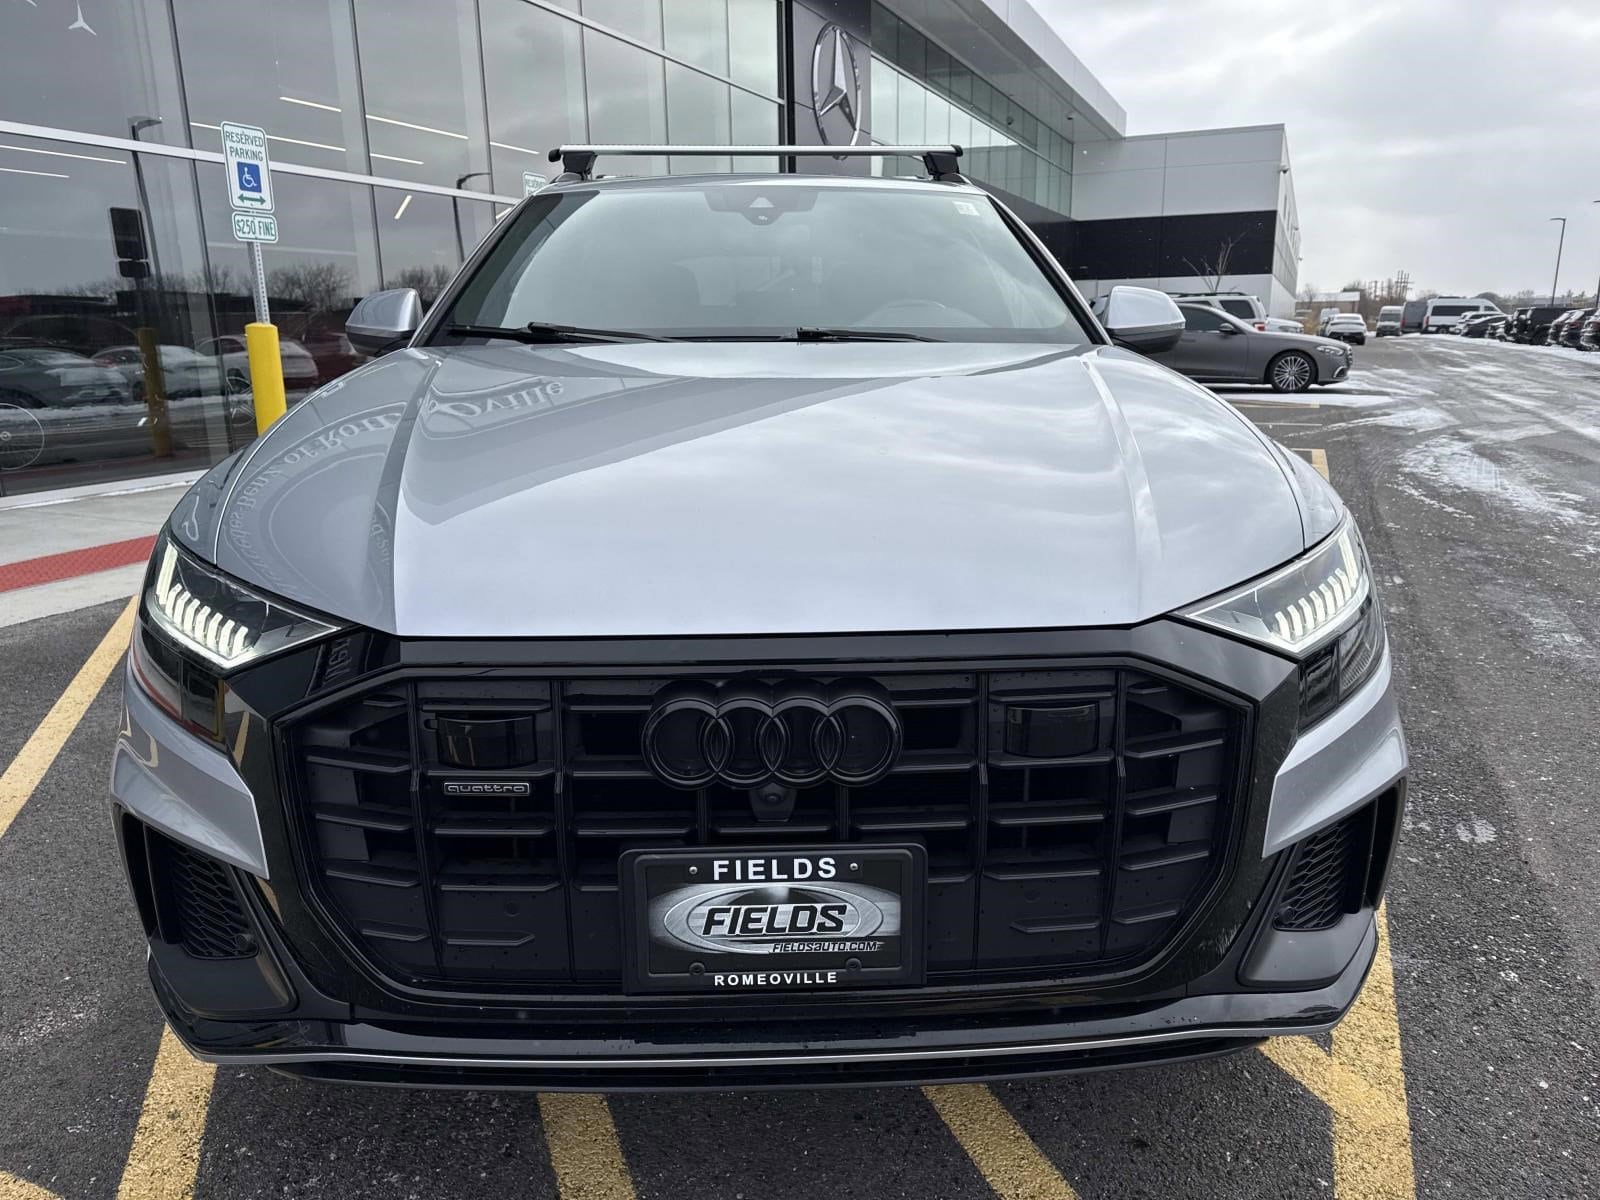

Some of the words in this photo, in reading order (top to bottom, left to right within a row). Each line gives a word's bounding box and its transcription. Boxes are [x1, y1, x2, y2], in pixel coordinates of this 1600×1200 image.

[225, 130, 264, 148] RESERVED
[229, 146, 264, 161] PARKING
[236, 219, 256, 235] $250
[258, 221, 275, 237] FINE
[447, 784, 525, 793] quattro
[712, 857, 837, 881] FIELDS
[701, 904, 848, 936] FIELDS
[714, 971, 838, 986] ROMEOVILLE
